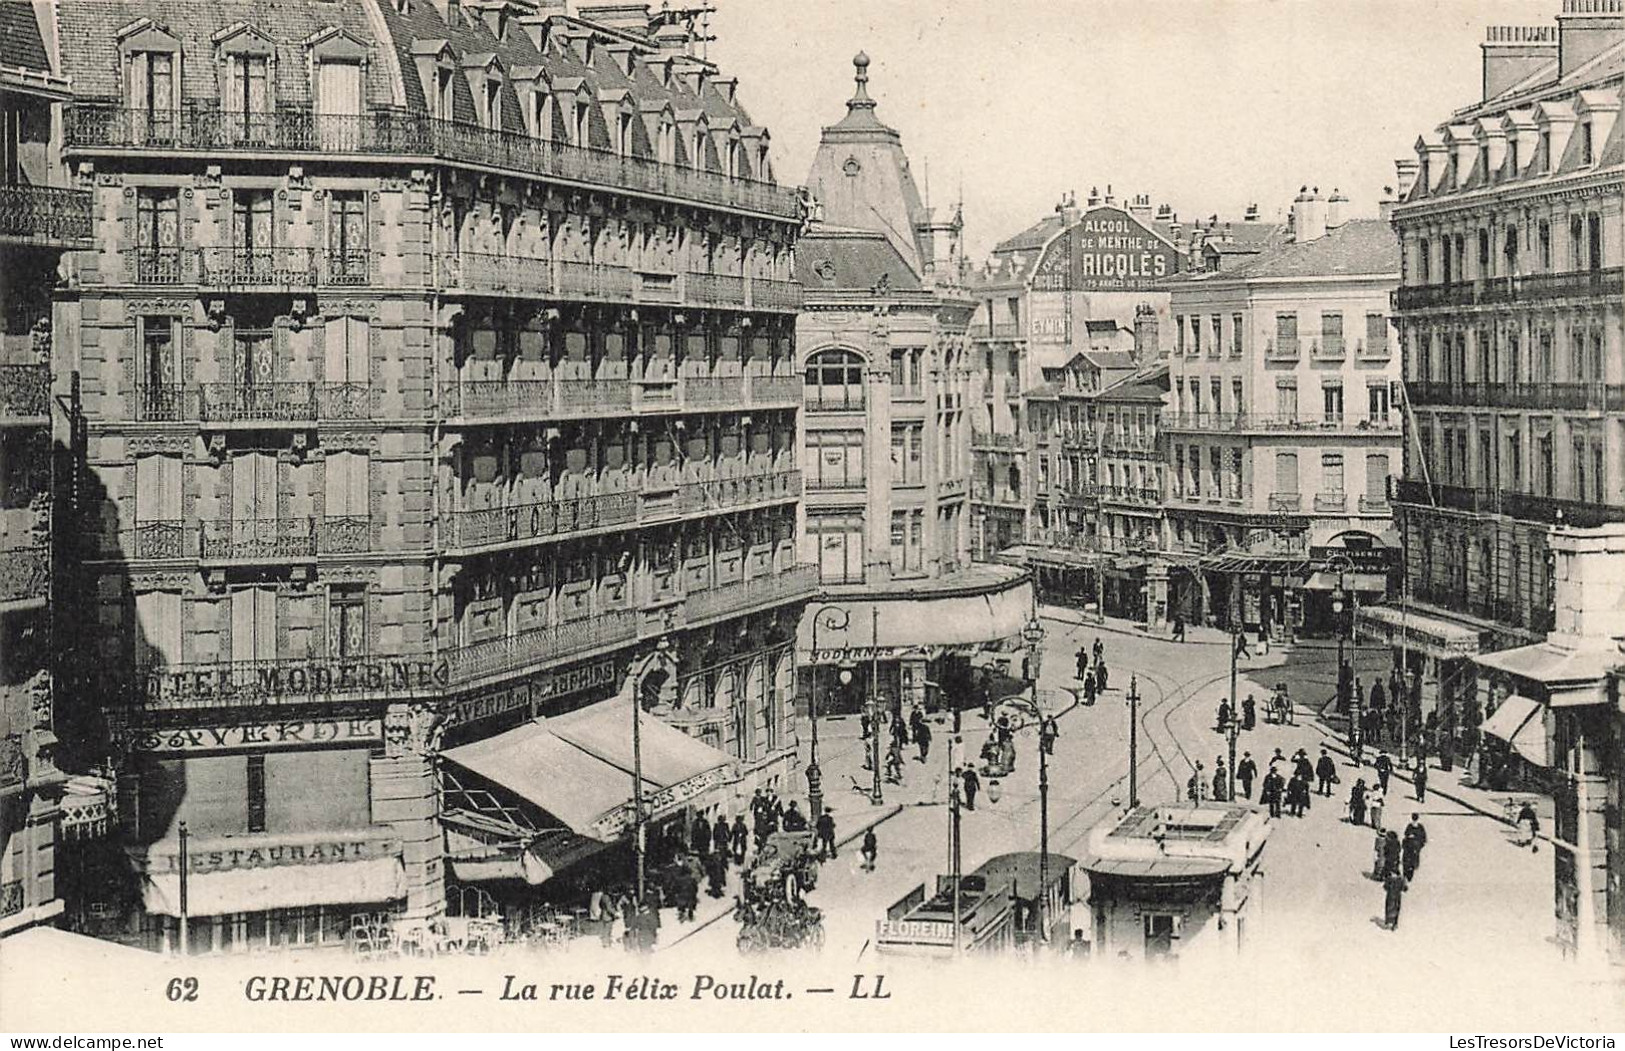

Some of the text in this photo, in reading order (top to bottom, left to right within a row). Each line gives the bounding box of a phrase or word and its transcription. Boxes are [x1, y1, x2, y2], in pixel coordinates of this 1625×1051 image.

[1085, 220, 1130, 232] ALCOOL
[1082, 236, 1159, 249] DE MENTHE DE
[1083, 250, 1166, 279] RICQLÈS
[258, 660, 433, 693] MODERNE
[652, 788, 676, 809] DES
